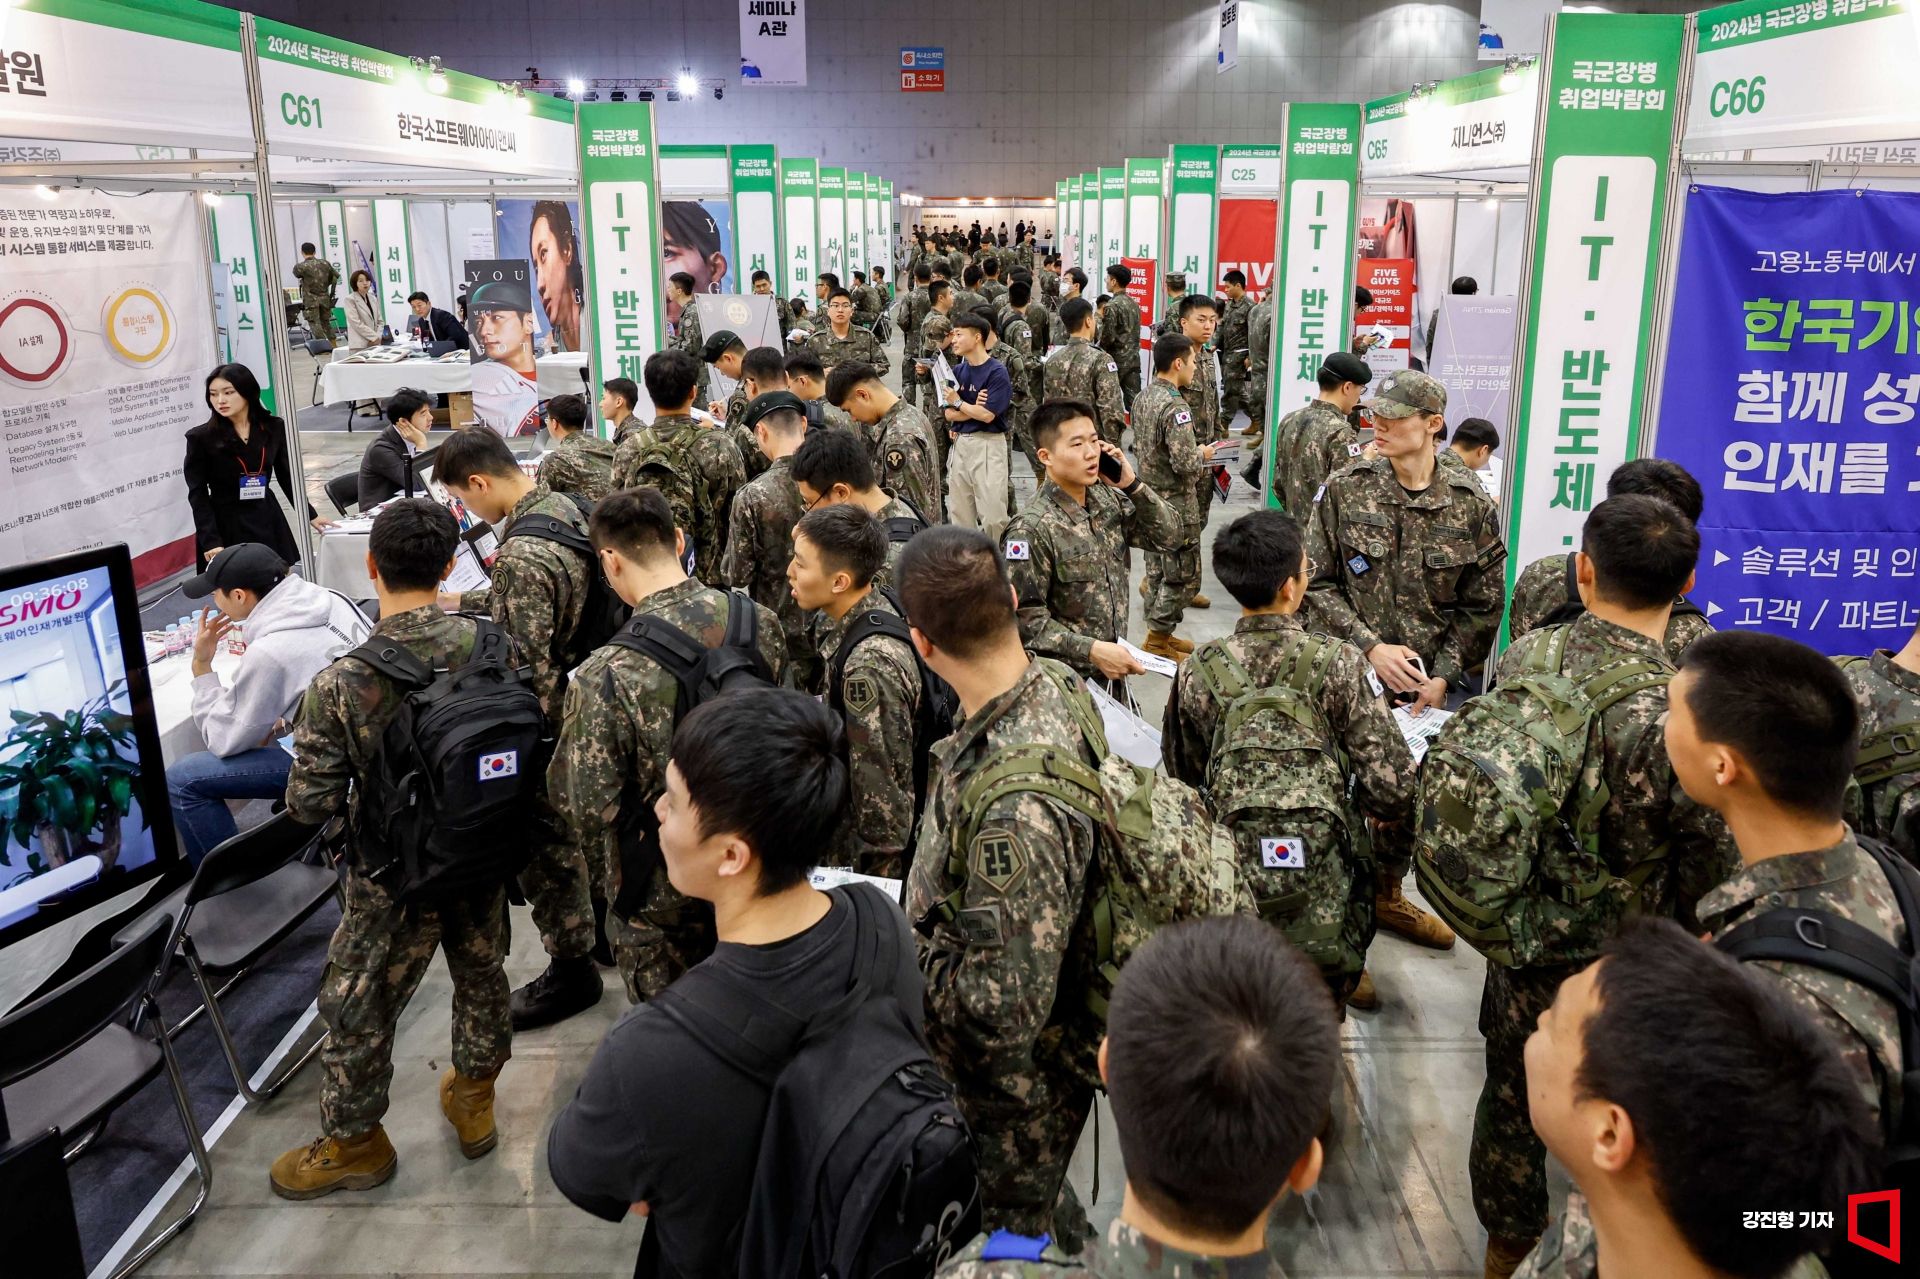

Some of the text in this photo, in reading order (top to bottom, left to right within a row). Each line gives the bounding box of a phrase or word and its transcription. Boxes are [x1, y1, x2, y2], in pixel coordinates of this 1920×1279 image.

[748, 1, 796, 16] 세미나
[758, 21, 787, 37] A관
[1711, 0, 1828, 42] 2024년 국군장병
[267, 35, 394, 80] 2024년 국군장병 취업박람회
[918, 74, 940, 82] 소화기
[1572, 61, 1658, 84] 국군장병
[1558, 88, 1666, 111] 취업박람회
[1709, 75, 1767, 118] C66
[280, 92, 323, 128] C61
[397, 112, 517, 153] 한국소프트웨어아이앤씨
[592, 129, 640, 142] 국군장병
[1300, 127, 1348, 141] 국군장병
[587, 144, 646, 157] 취업박람회
[1293, 142, 1353, 155] 취업박람회
[1367, 139, 1388, 160] C65
[738, 159, 768, 167] 국군장병
[1180, 160, 1210, 169] 국군장병
[735, 168, 772, 176] 취업박람회
[1176, 169, 1214, 179] 취업박람회
[1231, 168, 1256, 181] C25
[17, 209, 47, 221] 전문가
[48, 209, 78, 220] 역량과
[33, 225, 78, 238] 유지보수의
[106, 224, 134, 235] 단계를
[9, 242, 46, 256] 시스템
[48, 241, 67, 255] 통합
[69, 240, 106, 253] 서비스를
[1750, 250, 1917, 276] 고용노동부에서
[387, 246, 405, 304] 서비스
[471, 270, 524, 281] YOU
[1130, 268, 1146, 277] FIVE
[1374, 268, 1398, 276] FIVE
[1370, 277, 1400, 286] GUYS
[231, 256, 254, 331] 서비스
[29, 335, 44, 346] 설계
[1733, 369, 1848, 424] 함께
[1723, 440, 1889, 494] 인재를
[1742, 545, 1918, 578] 솔루션 및 인
[10, 577, 89, 607] 09:36:08
[1734, 597, 1802, 629] 고객
[1809, 599, 1830, 631] /
[0, 611, 85, 642] 웨어인재개발원
